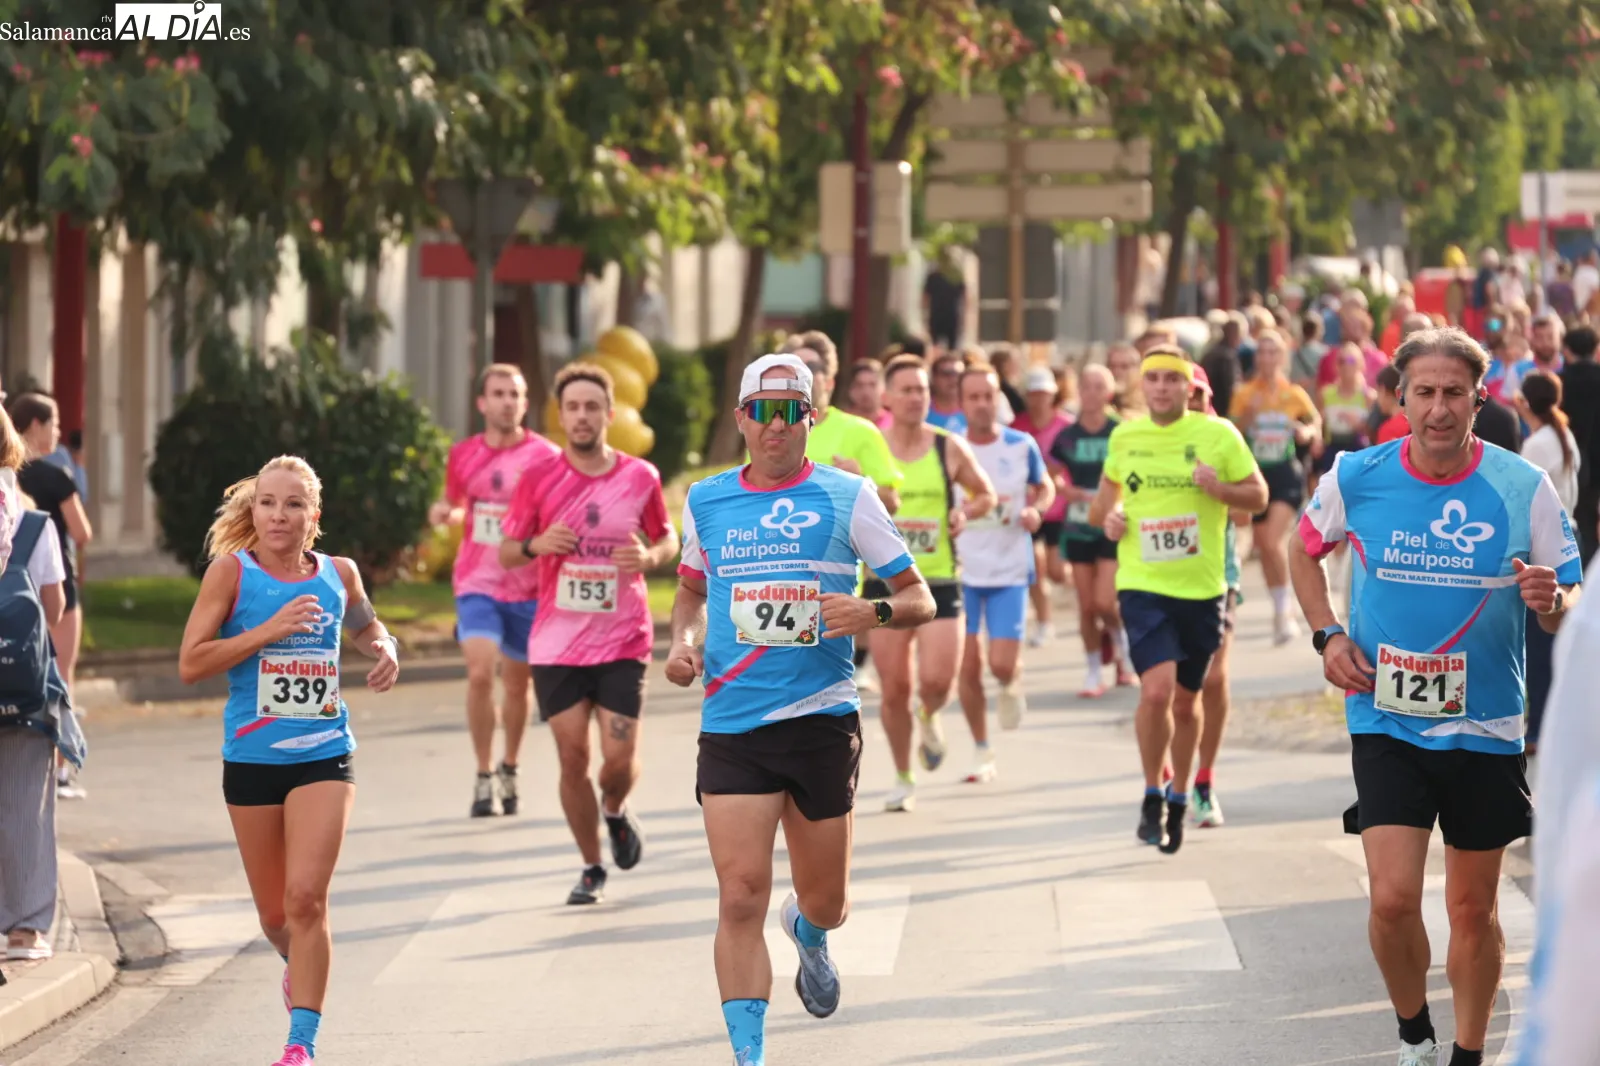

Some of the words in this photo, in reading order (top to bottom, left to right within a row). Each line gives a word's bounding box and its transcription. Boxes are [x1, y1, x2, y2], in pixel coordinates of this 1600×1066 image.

[726, 527, 759, 543] Piel
[764, 530, 778, 539] de
[1151, 529, 1190, 551] 186
[1391, 530, 1428, 549] Piel
[1435, 539, 1450, 550] de
[721, 542, 800, 560] Mariposa
[1383, 547, 1474, 570] Mariposa
[744, 565, 769, 573] MARTA
[780, 562, 809, 570] TORMES
[1382, 571, 1407, 580] SANTA
[1408, 574, 1436, 583] MARTA
[1438, 576, 1448, 584] DE
[1450, 577, 1482, 586] TORMES
[568, 580, 607, 601] 153
[733, 585, 818, 602] bedunia
[755, 602, 796, 631] 94
[261, 659, 337, 677] bedunia
[1379, 647, 1465, 673] bedunia
[272, 676, 327, 705] 339
[1391, 670, 1447, 702] 121
